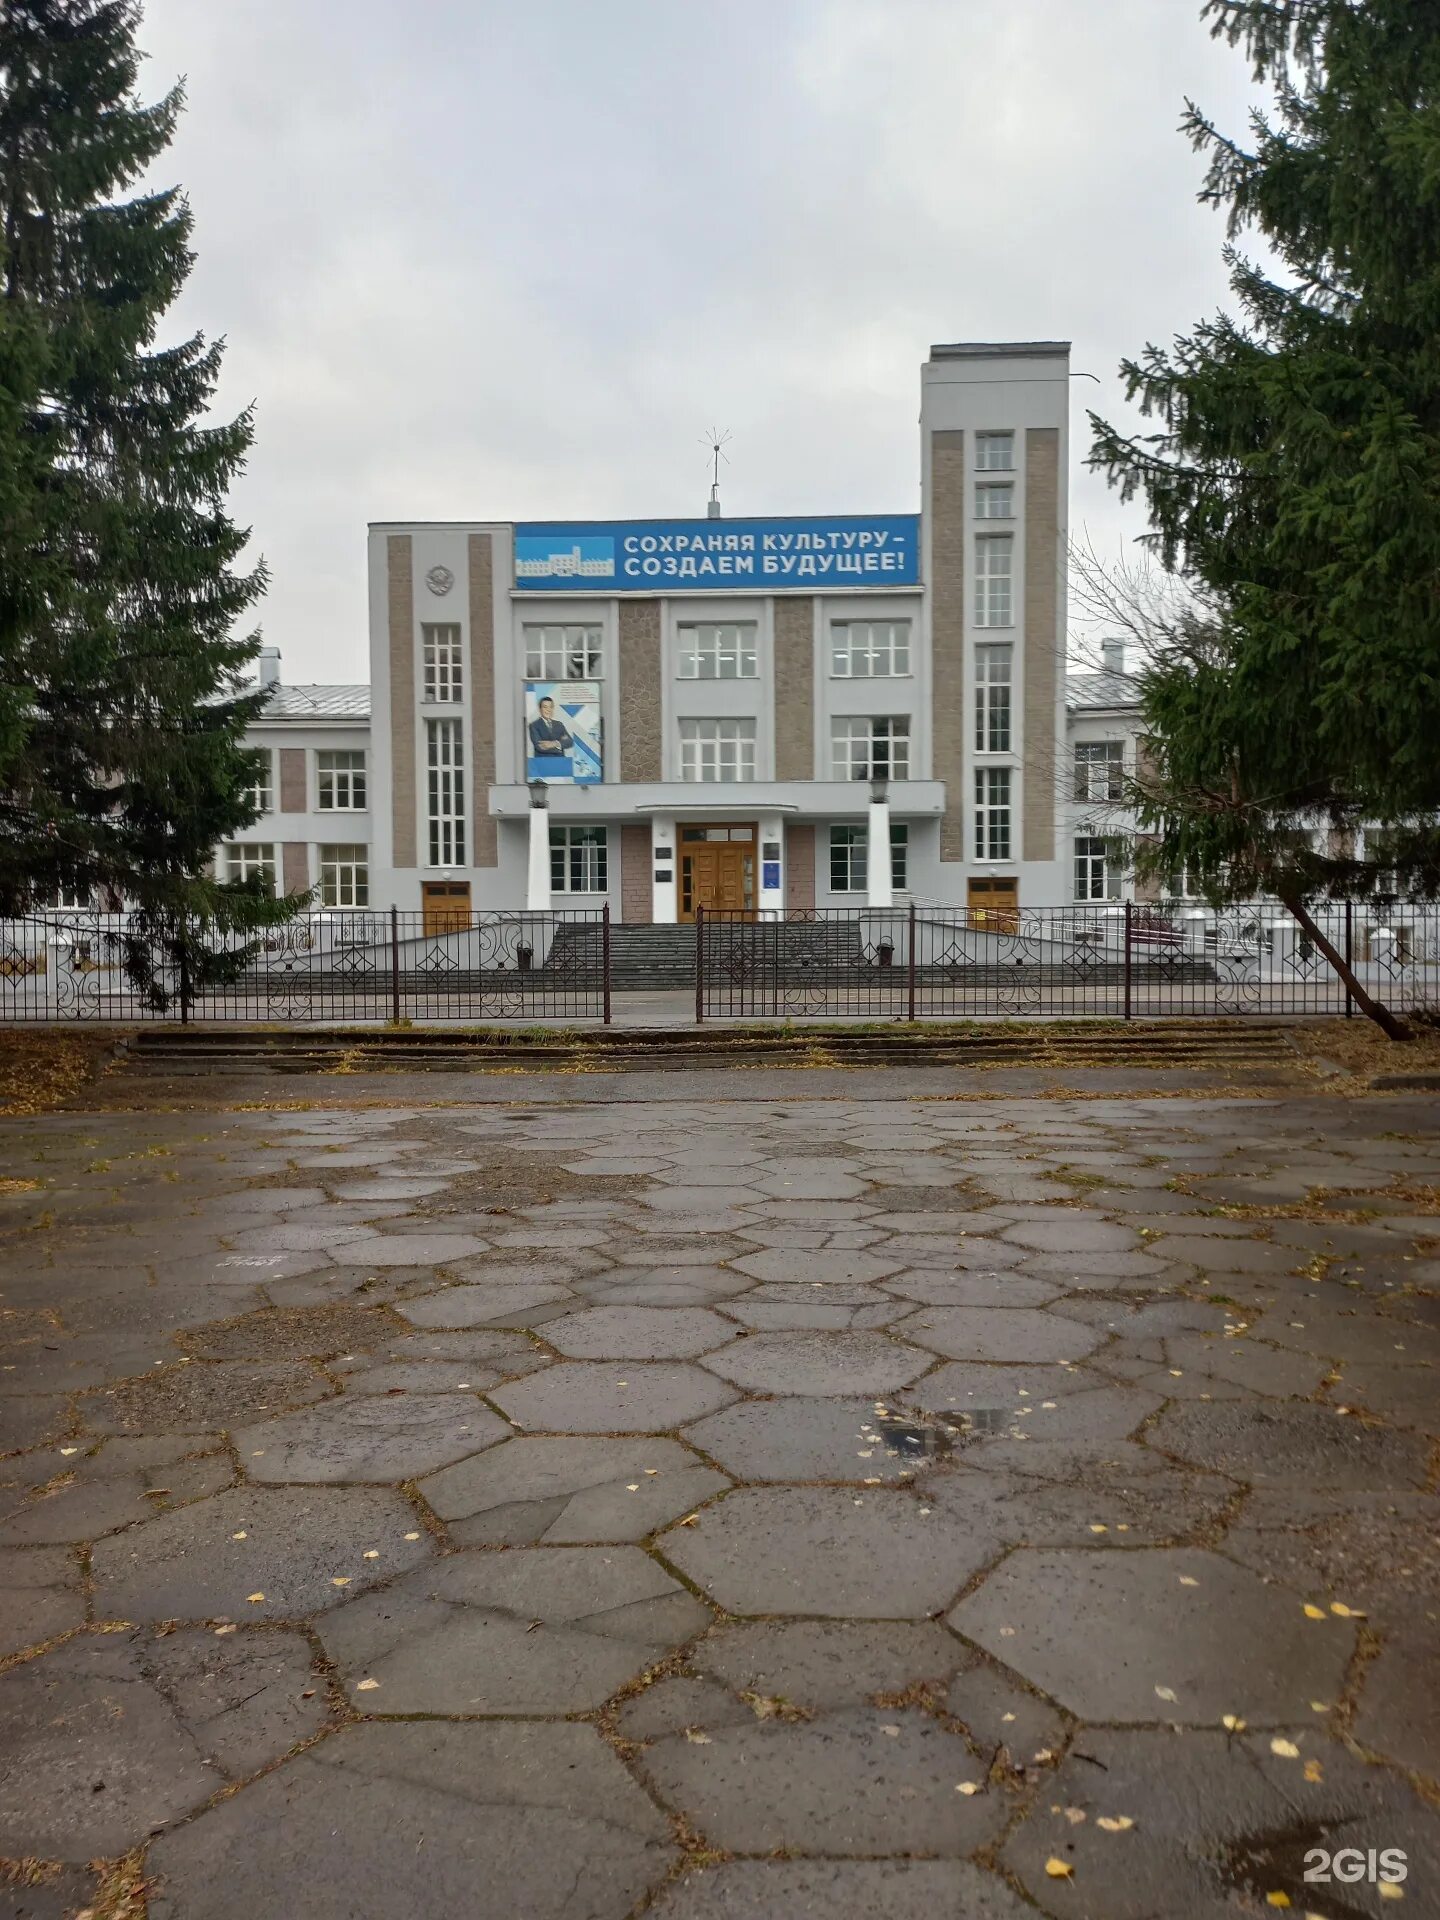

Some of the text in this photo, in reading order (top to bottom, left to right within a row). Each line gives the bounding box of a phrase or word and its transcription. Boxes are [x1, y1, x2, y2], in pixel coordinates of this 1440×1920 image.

[624, 535, 755, 552] СОХРАНЯЯ
[763, 531, 888, 550] КУЛЬТУРУ
[624, 552, 904, 577] СОЗДАЕМ БУДУЩЕЕ!
